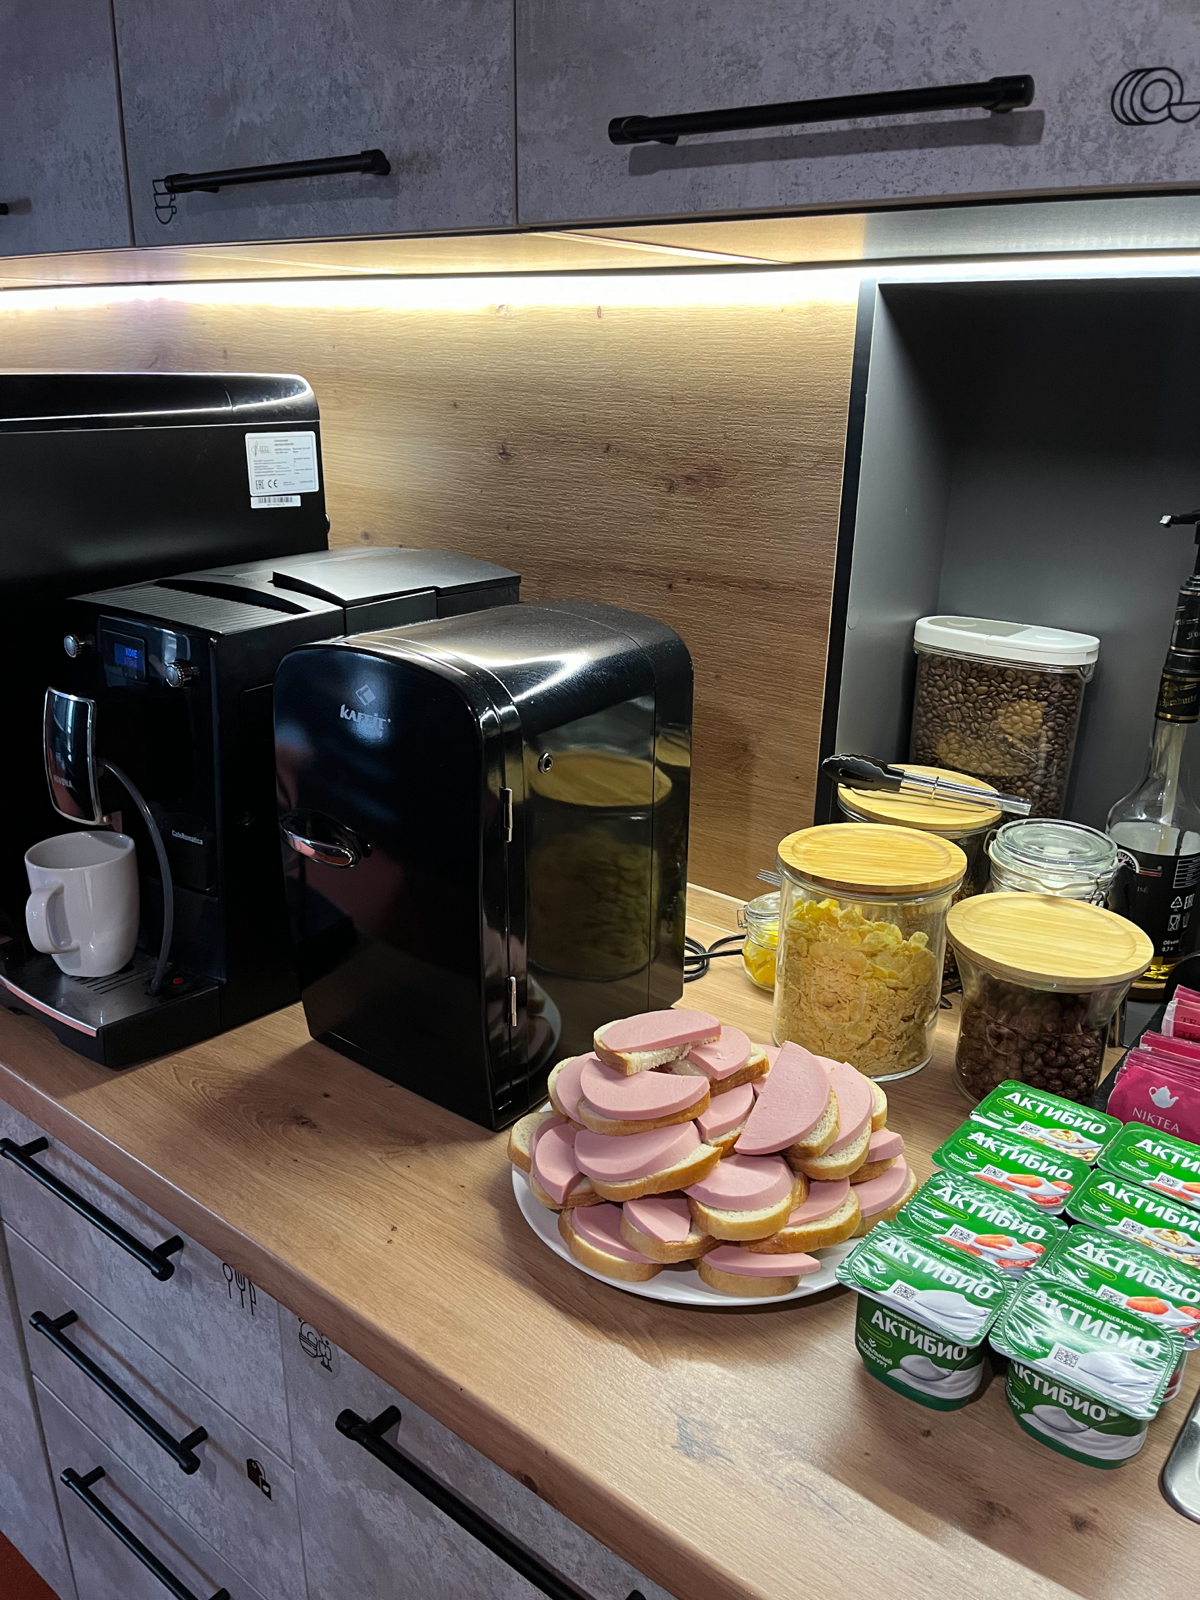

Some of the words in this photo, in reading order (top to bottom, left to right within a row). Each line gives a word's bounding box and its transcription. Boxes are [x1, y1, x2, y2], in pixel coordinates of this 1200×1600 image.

[1004, 1092, 1107, 1134] АКТИБИО
[1132, 1107, 1180, 1134] NIKTEA
[967, 1132, 1073, 1180] АКТИБИО
[1134, 1139, 1200, 1174] АКТИ
[933, 1187, 1047, 1240] АКТИБИО
[1097, 1181, 1200, 1231] АКТИБИ
[877, 1236, 996, 1299] АКТИБИО
[1074, 1242, 1200, 1303] АКТИБИО
[871, 1310, 968, 1361] АКТИБИО
[1028, 1290, 1160, 1359] АКТИБИО
